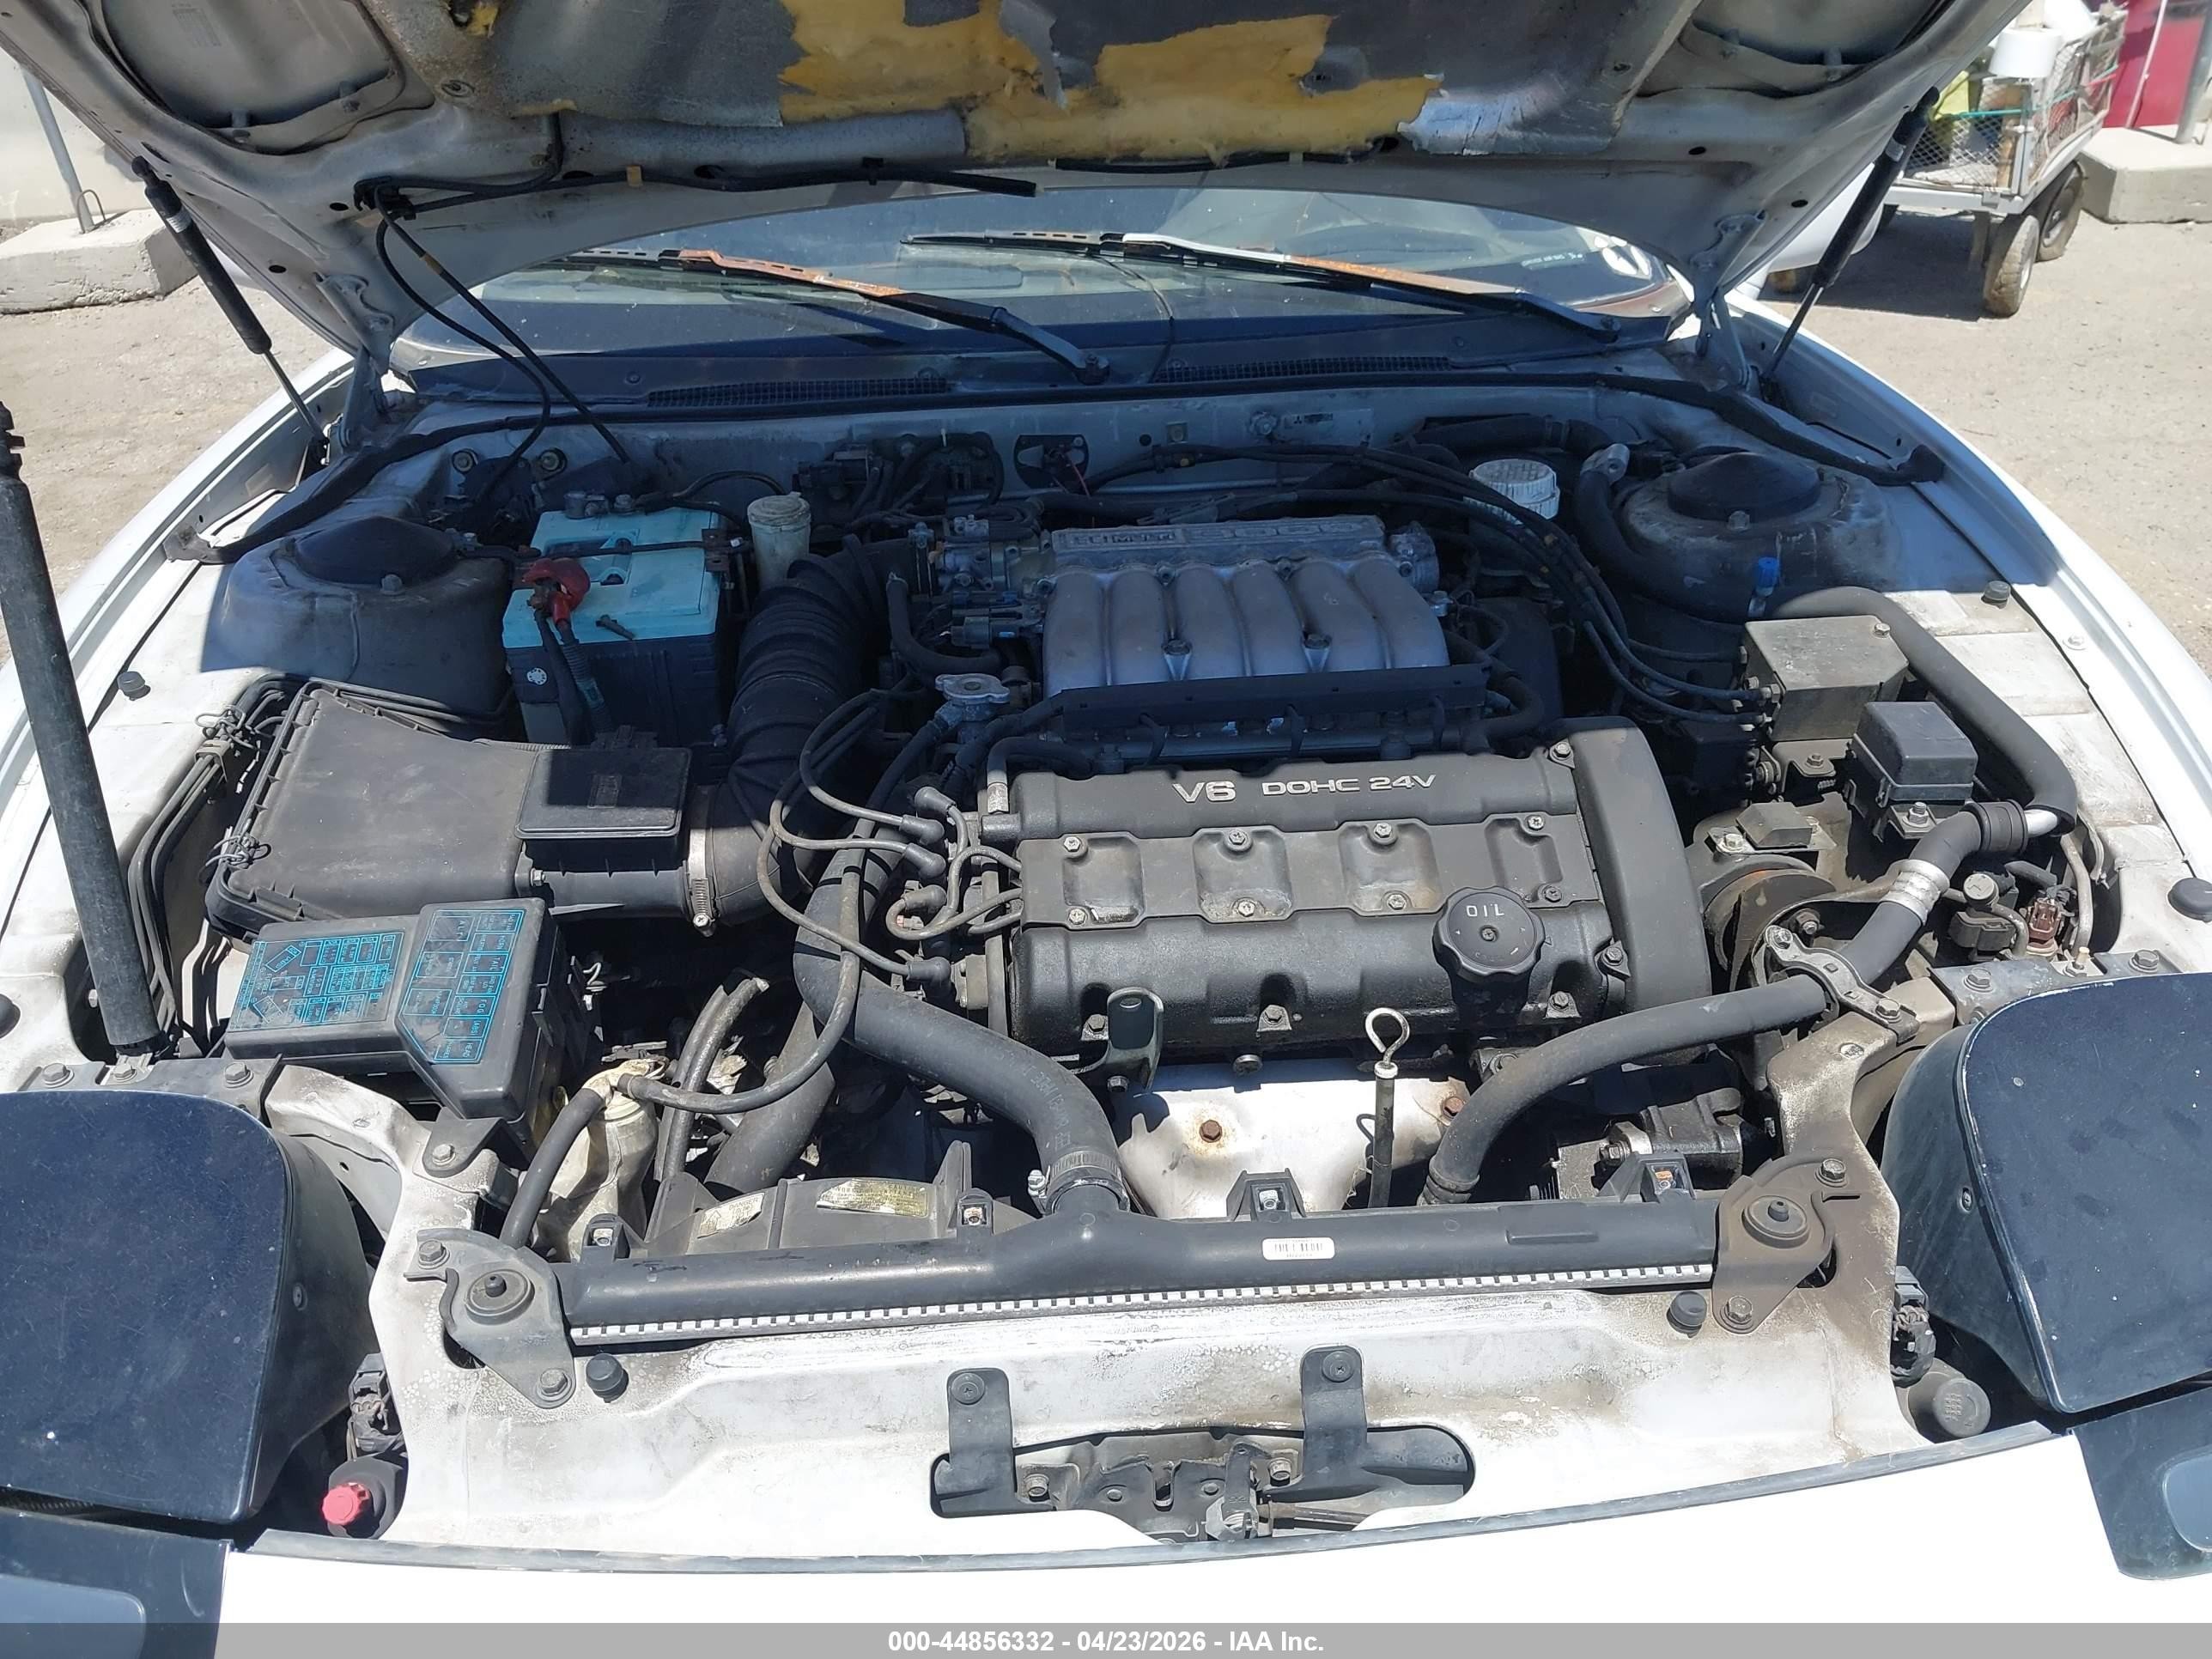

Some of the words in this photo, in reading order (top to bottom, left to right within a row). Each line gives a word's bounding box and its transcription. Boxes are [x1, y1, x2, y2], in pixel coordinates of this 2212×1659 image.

[1172, 781, 1237, 803] V6
[1261, 778, 1361, 797] DOHC
[1368, 773, 1437, 791] 24V
[1466, 903, 1505, 918] OIL
[489, 956, 501, 971] TAIL
[477, 999, 487, 1014] FOG
[462, 1042, 473, 1058] HEAD
